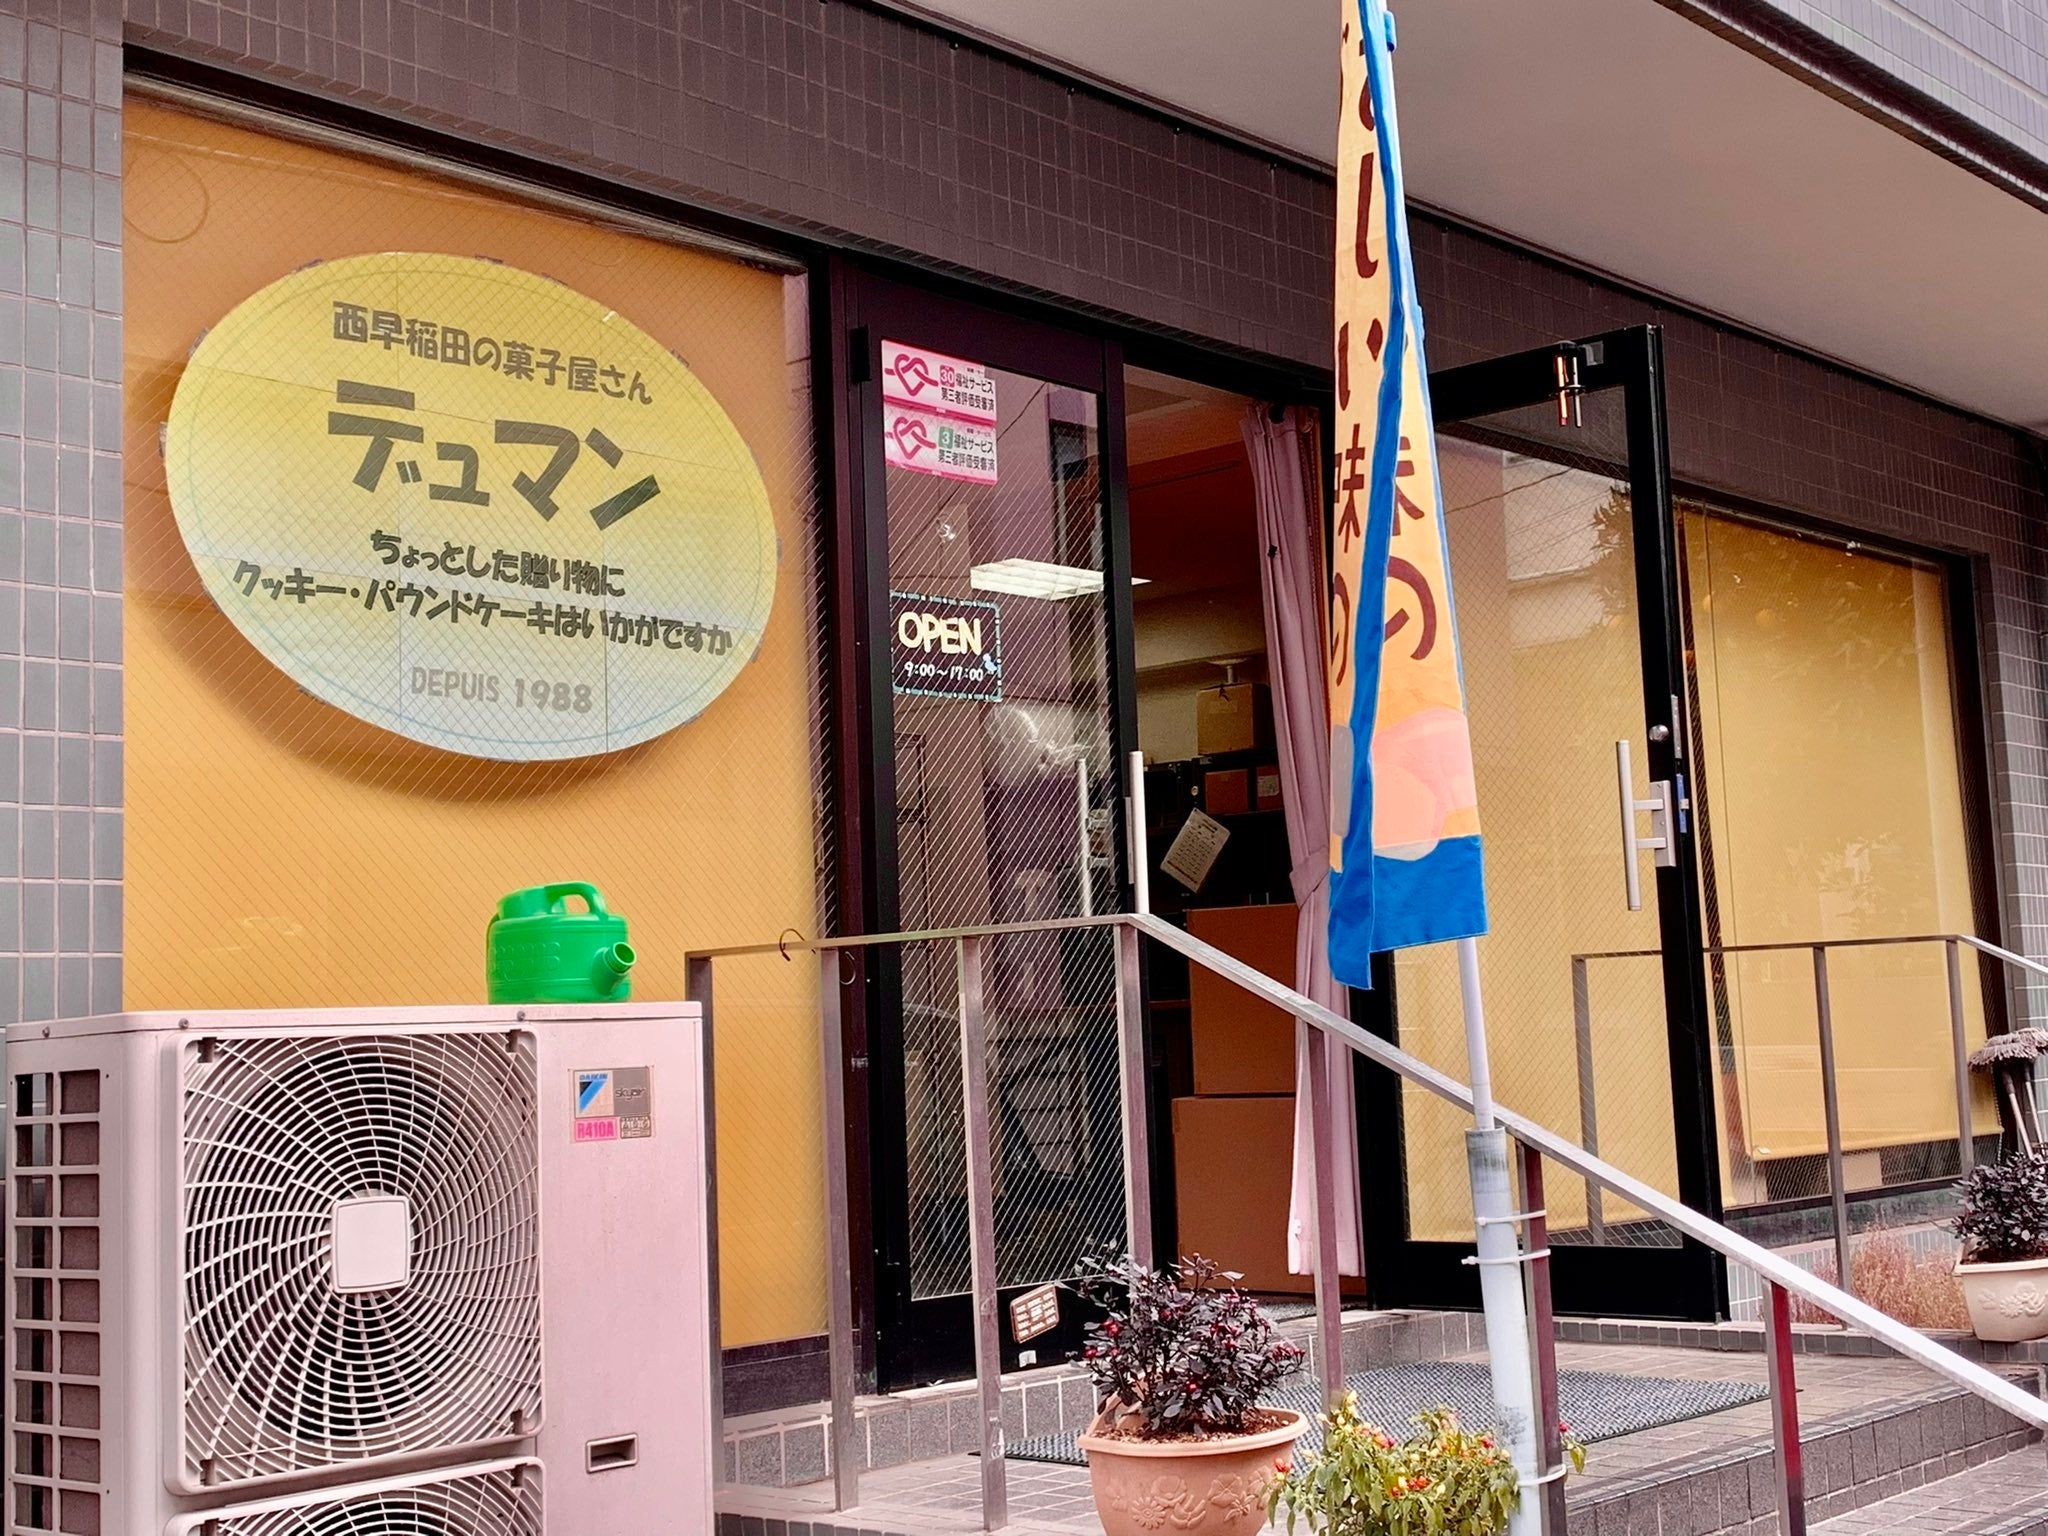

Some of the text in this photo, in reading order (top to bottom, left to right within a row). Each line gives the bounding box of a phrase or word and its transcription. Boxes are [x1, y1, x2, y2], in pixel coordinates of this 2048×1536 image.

[333, 301, 653, 406] 西早稲田の菓子屋さん
[328, 379, 661, 531] デュマン
[370, 529, 626, 597] ちょっとした贈り物に
[232, 560, 733, 656] クッキー・パウンドケーキはいかがですか
[898, 611, 982, 656] OPEN
[411, 666, 594, 714] DEPUIS 1988
[579, 1073, 608, 1081] DAIKIN
[577, 1121, 614, 1139] R410A
